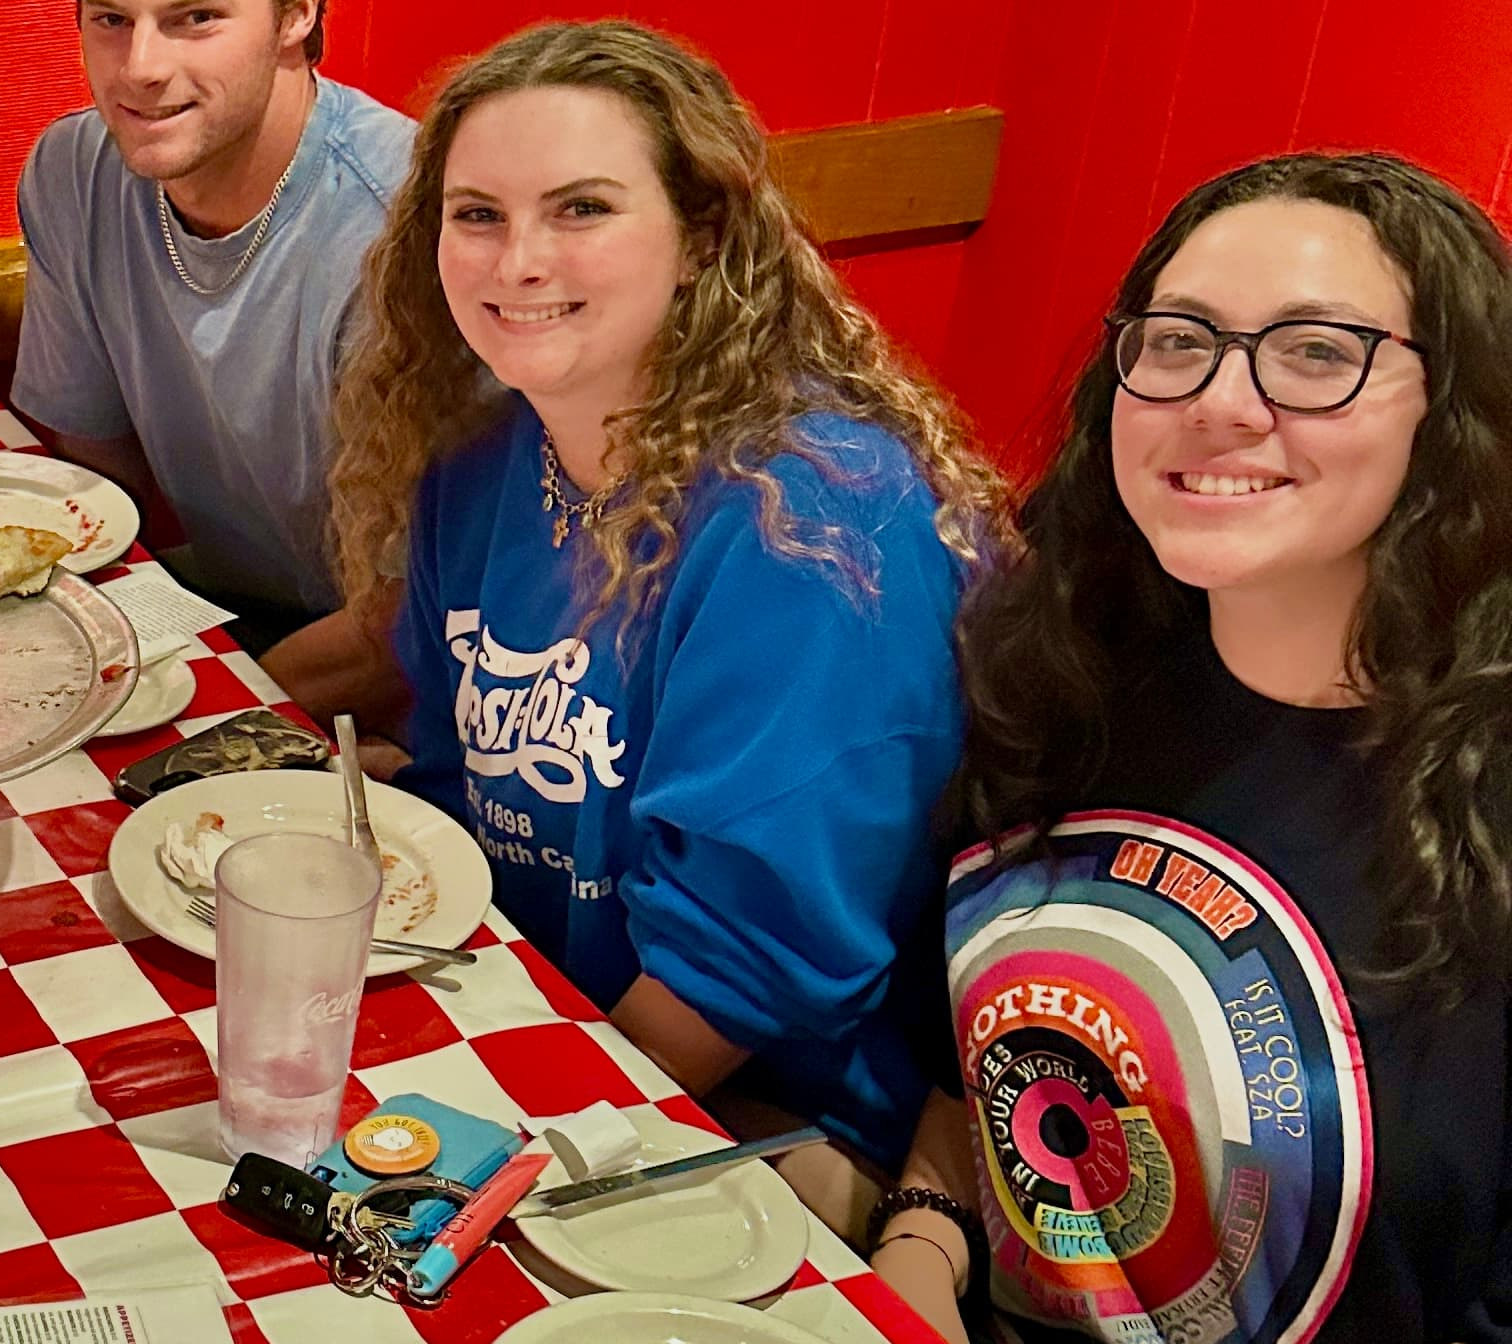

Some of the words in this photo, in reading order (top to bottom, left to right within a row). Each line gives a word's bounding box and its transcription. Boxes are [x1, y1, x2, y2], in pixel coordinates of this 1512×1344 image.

[486, 801, 534, 839] 1898
[1109, 838, 1165, 887] OH
[1155, 851, 1258, 942] YEAH?
[1244, 978, 1275, 1002] IS
[1254, 1004, 1286, 1026] IT
[1014, 1057, 1089, 1094] WORLD
[1224, 998, 1264, 1065] FEAT.
[1247, 1072, 1274, 1122] SZA
[1264, 1035, 1307, 1139] COOL?
